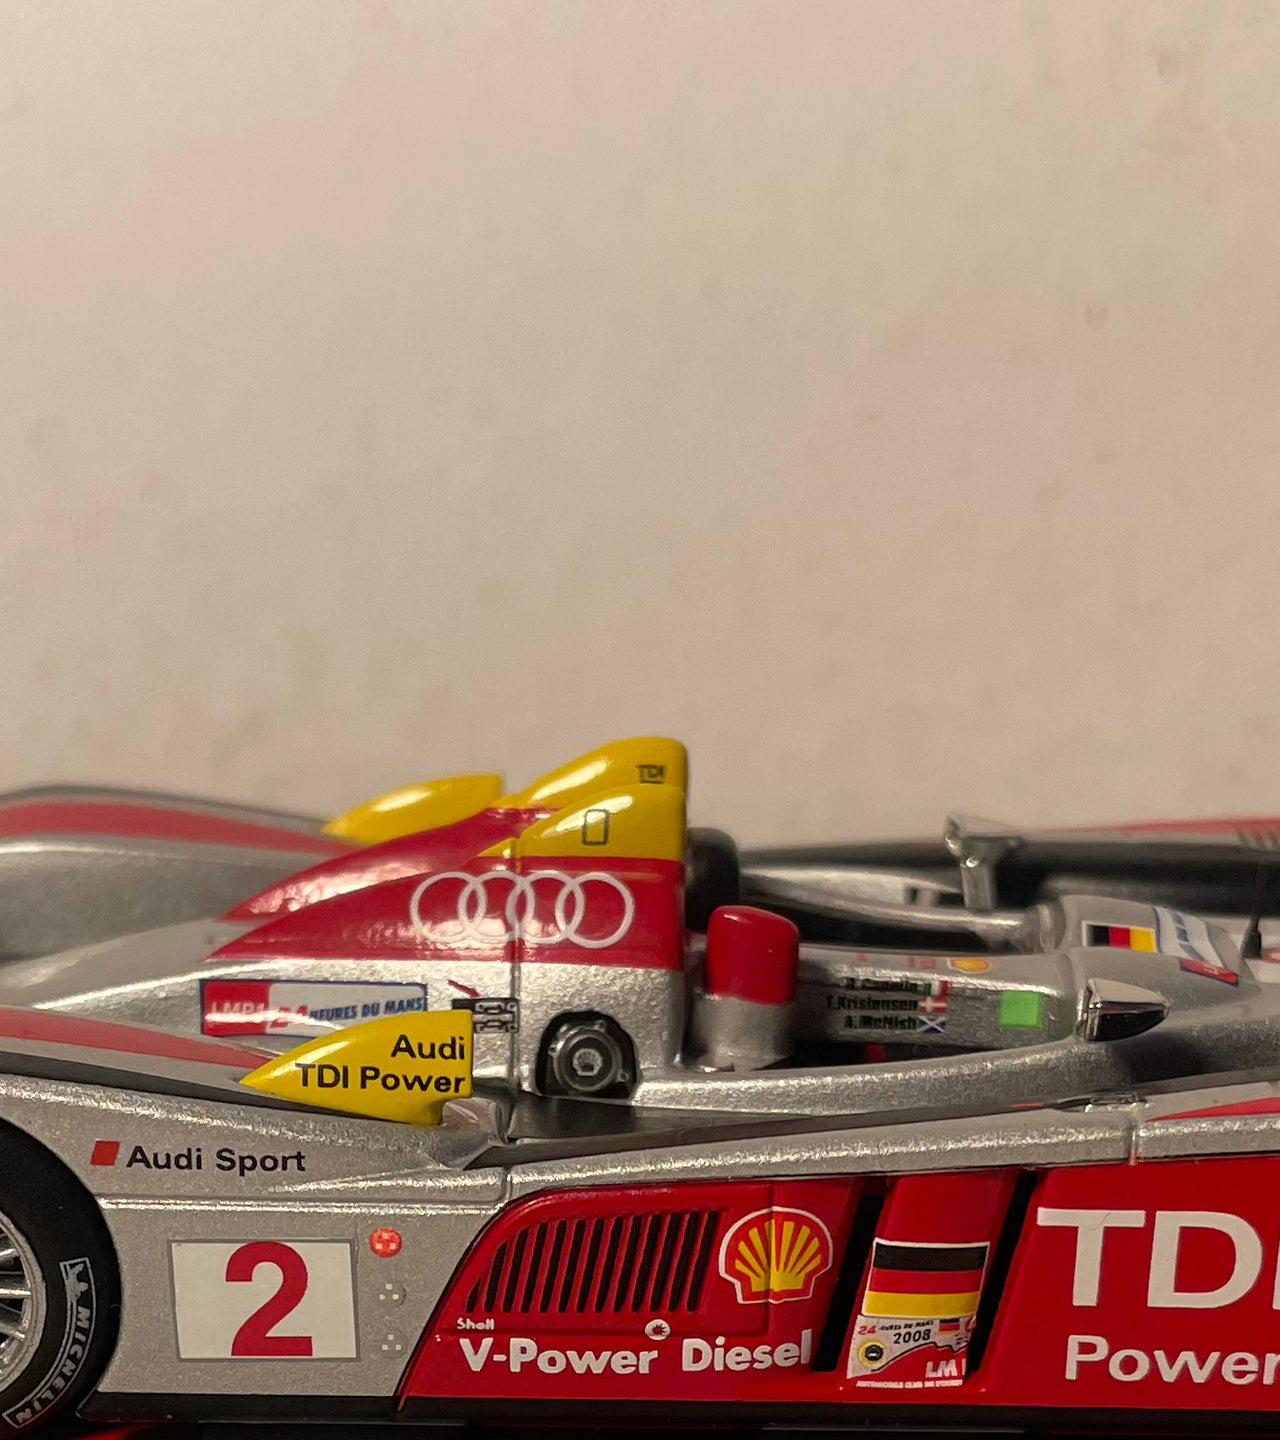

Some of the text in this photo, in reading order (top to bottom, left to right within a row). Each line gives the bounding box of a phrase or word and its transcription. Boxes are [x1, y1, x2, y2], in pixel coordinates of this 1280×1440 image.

[361, 1003, 379, 1017] DU
[382, 997, 423, 1014] MANS
[390, 1034, 465, 1060] Audi
[295, 1063, 465, 1094] TDI Power
[126, 1145, 306, 1176] Audi Sport
[225, 1241, 313, 1356] 2
[456, 1317, 495, 1330] Shell
[858, 1325, 877, 1335] 24
[893, 1329, 932, 1344] 2008
[15, 1305, 91, 1423] MICHELIN
[459, 1328, 812, 1374] V-Power Diesel
